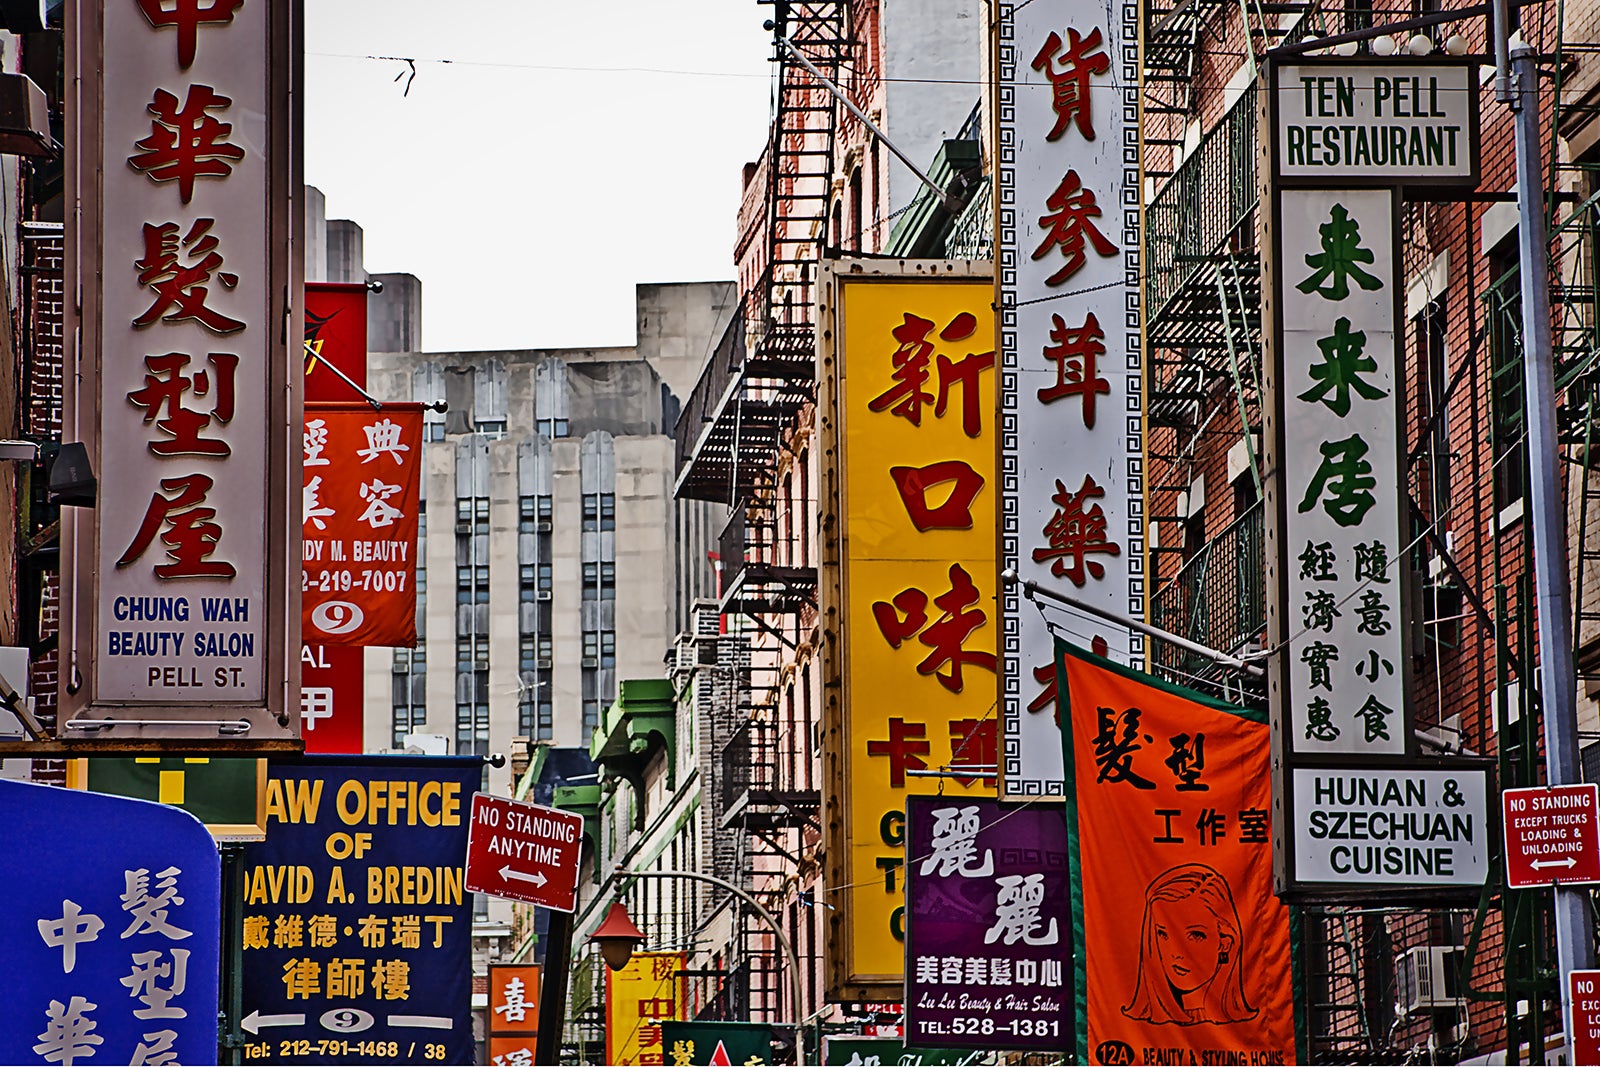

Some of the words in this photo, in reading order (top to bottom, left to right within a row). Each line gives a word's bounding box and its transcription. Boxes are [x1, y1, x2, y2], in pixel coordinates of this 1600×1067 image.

[1300, 76, 1353, 118] TEN
[1373, 76, 1446, 118] PELL
[1287, 125, 1460, 167] RESTAURANT
[868, 312, 997, 692] 新口味
[303, 540, 323, 561] DY
[331, 540, 347, 561] M.
[353, 541, 408, 562] BEAUTY
[113, 597, 190, 622] CHUNG
[201, 597, 249, 622] WAH
[108, 631, 185, 657] BEAUTY
[194, 632, 254, 658] SALON
[1298, 540, 1342, 742] 經濟實惠
[1353, 540, 1394, 743] 隨意小食
[148, 667, 203, 687] PELL
[214, 667, 246, 688] ST.
[1091, 706, 1210, 792] 髮型
[336, 780, 461, 826] OFFICE
[1314, 777, 1428, 807] HUNAN
[1440, 777, 1466, 808] &
[1510, 798, 1526, 812] NO
[1532, 794, 1590, 811] STANDING
[479, 805, 500, 827] NO
[506, 812, 575, 844] STANDING
[1153, 808, 1269, 846] 工作室
[1308, 810, 1473, 844] SZECHUAN
[1514, 816, 1547, 828] EXCEPT
[1552, 813, 1587, 825] TRUCKS
[1521, 829, 1567, 842] LOADING
[1573, 827, 1582, 838] &
[326, 832, 373, 860] OF
[488, 835, 562, 868] ANYTIME
[1329, 845, 1454, 876] CUISINE
[1522, 841, 1583, 856] UNLOADING
[327, 866, 355, 905] A.
[367, 866, 463, 906] BREDIN
[33, 899, 105, 1066] 中華
[282, 957, 411, 1001] 律師樓
[916, 955, 1062, 987] 美容美髮中心
[1577, 980, 1594, 994] NO
[959, 993, 992, 1014] Beauty
[994, 997, 1002, 1010] &
[1004, 994, 1029, 1011] Hair
[1031, 995, 1060, 1012] Salon
[279, 1040, 399, 1057] 212-791-1468
[424, 1044, 446, 1060] 38
[1099, 1043, 1131, 1065] 12A
[1143, 1048, 1185, 1066] BEAUTY
[1202, 1049, 1248, 1066] STYLING
[1252, 1050, 1285, 1066] HOUSE
